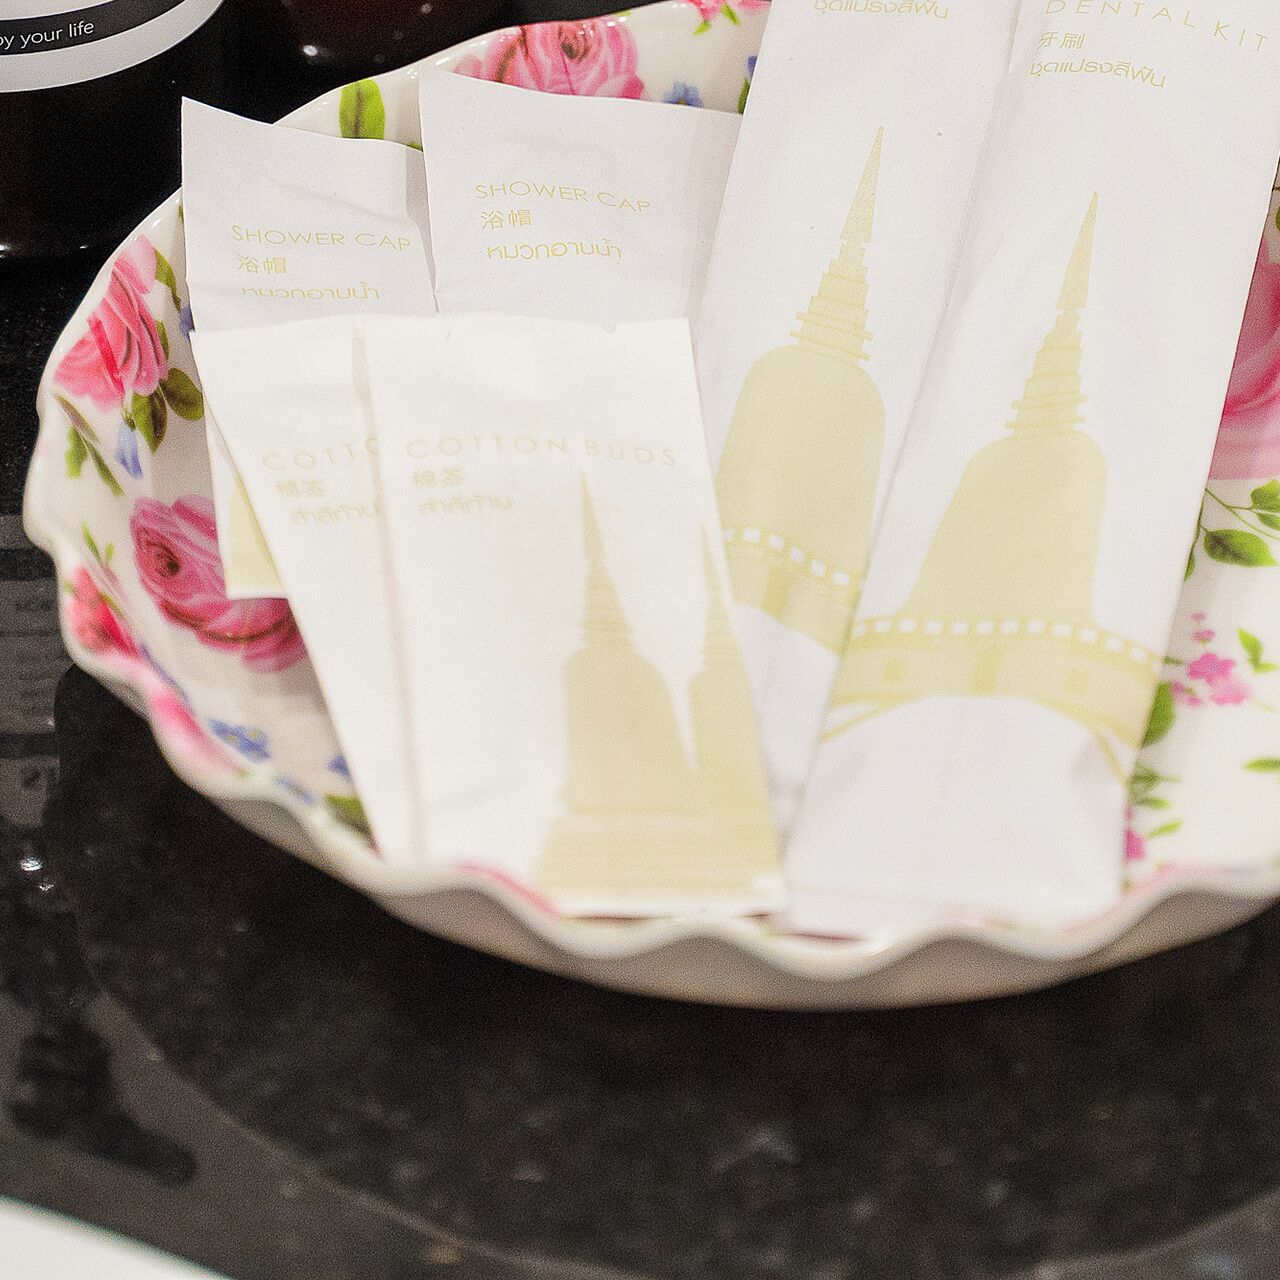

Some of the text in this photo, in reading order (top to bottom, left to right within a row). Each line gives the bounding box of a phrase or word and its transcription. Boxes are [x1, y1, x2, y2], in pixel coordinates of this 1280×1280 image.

[19, 27, 63, 48] your
[68, 19, 95, 38] life
[1037, 30, 1086, 50] 牙刷
[1213, 22, 1269, 53] KIT
[1030, 58, 1166, 88] ชุดแปรงสีฟัน
[475, 179, 652, 213] SHOWER CAP
[480, 208, 532, 230] 浴帽
[231, 224, 412, 252] SHOWER CAP
[237, 254, 287, 275] 浴帽
[406, 436, 678, 467] COTTON BUDS
